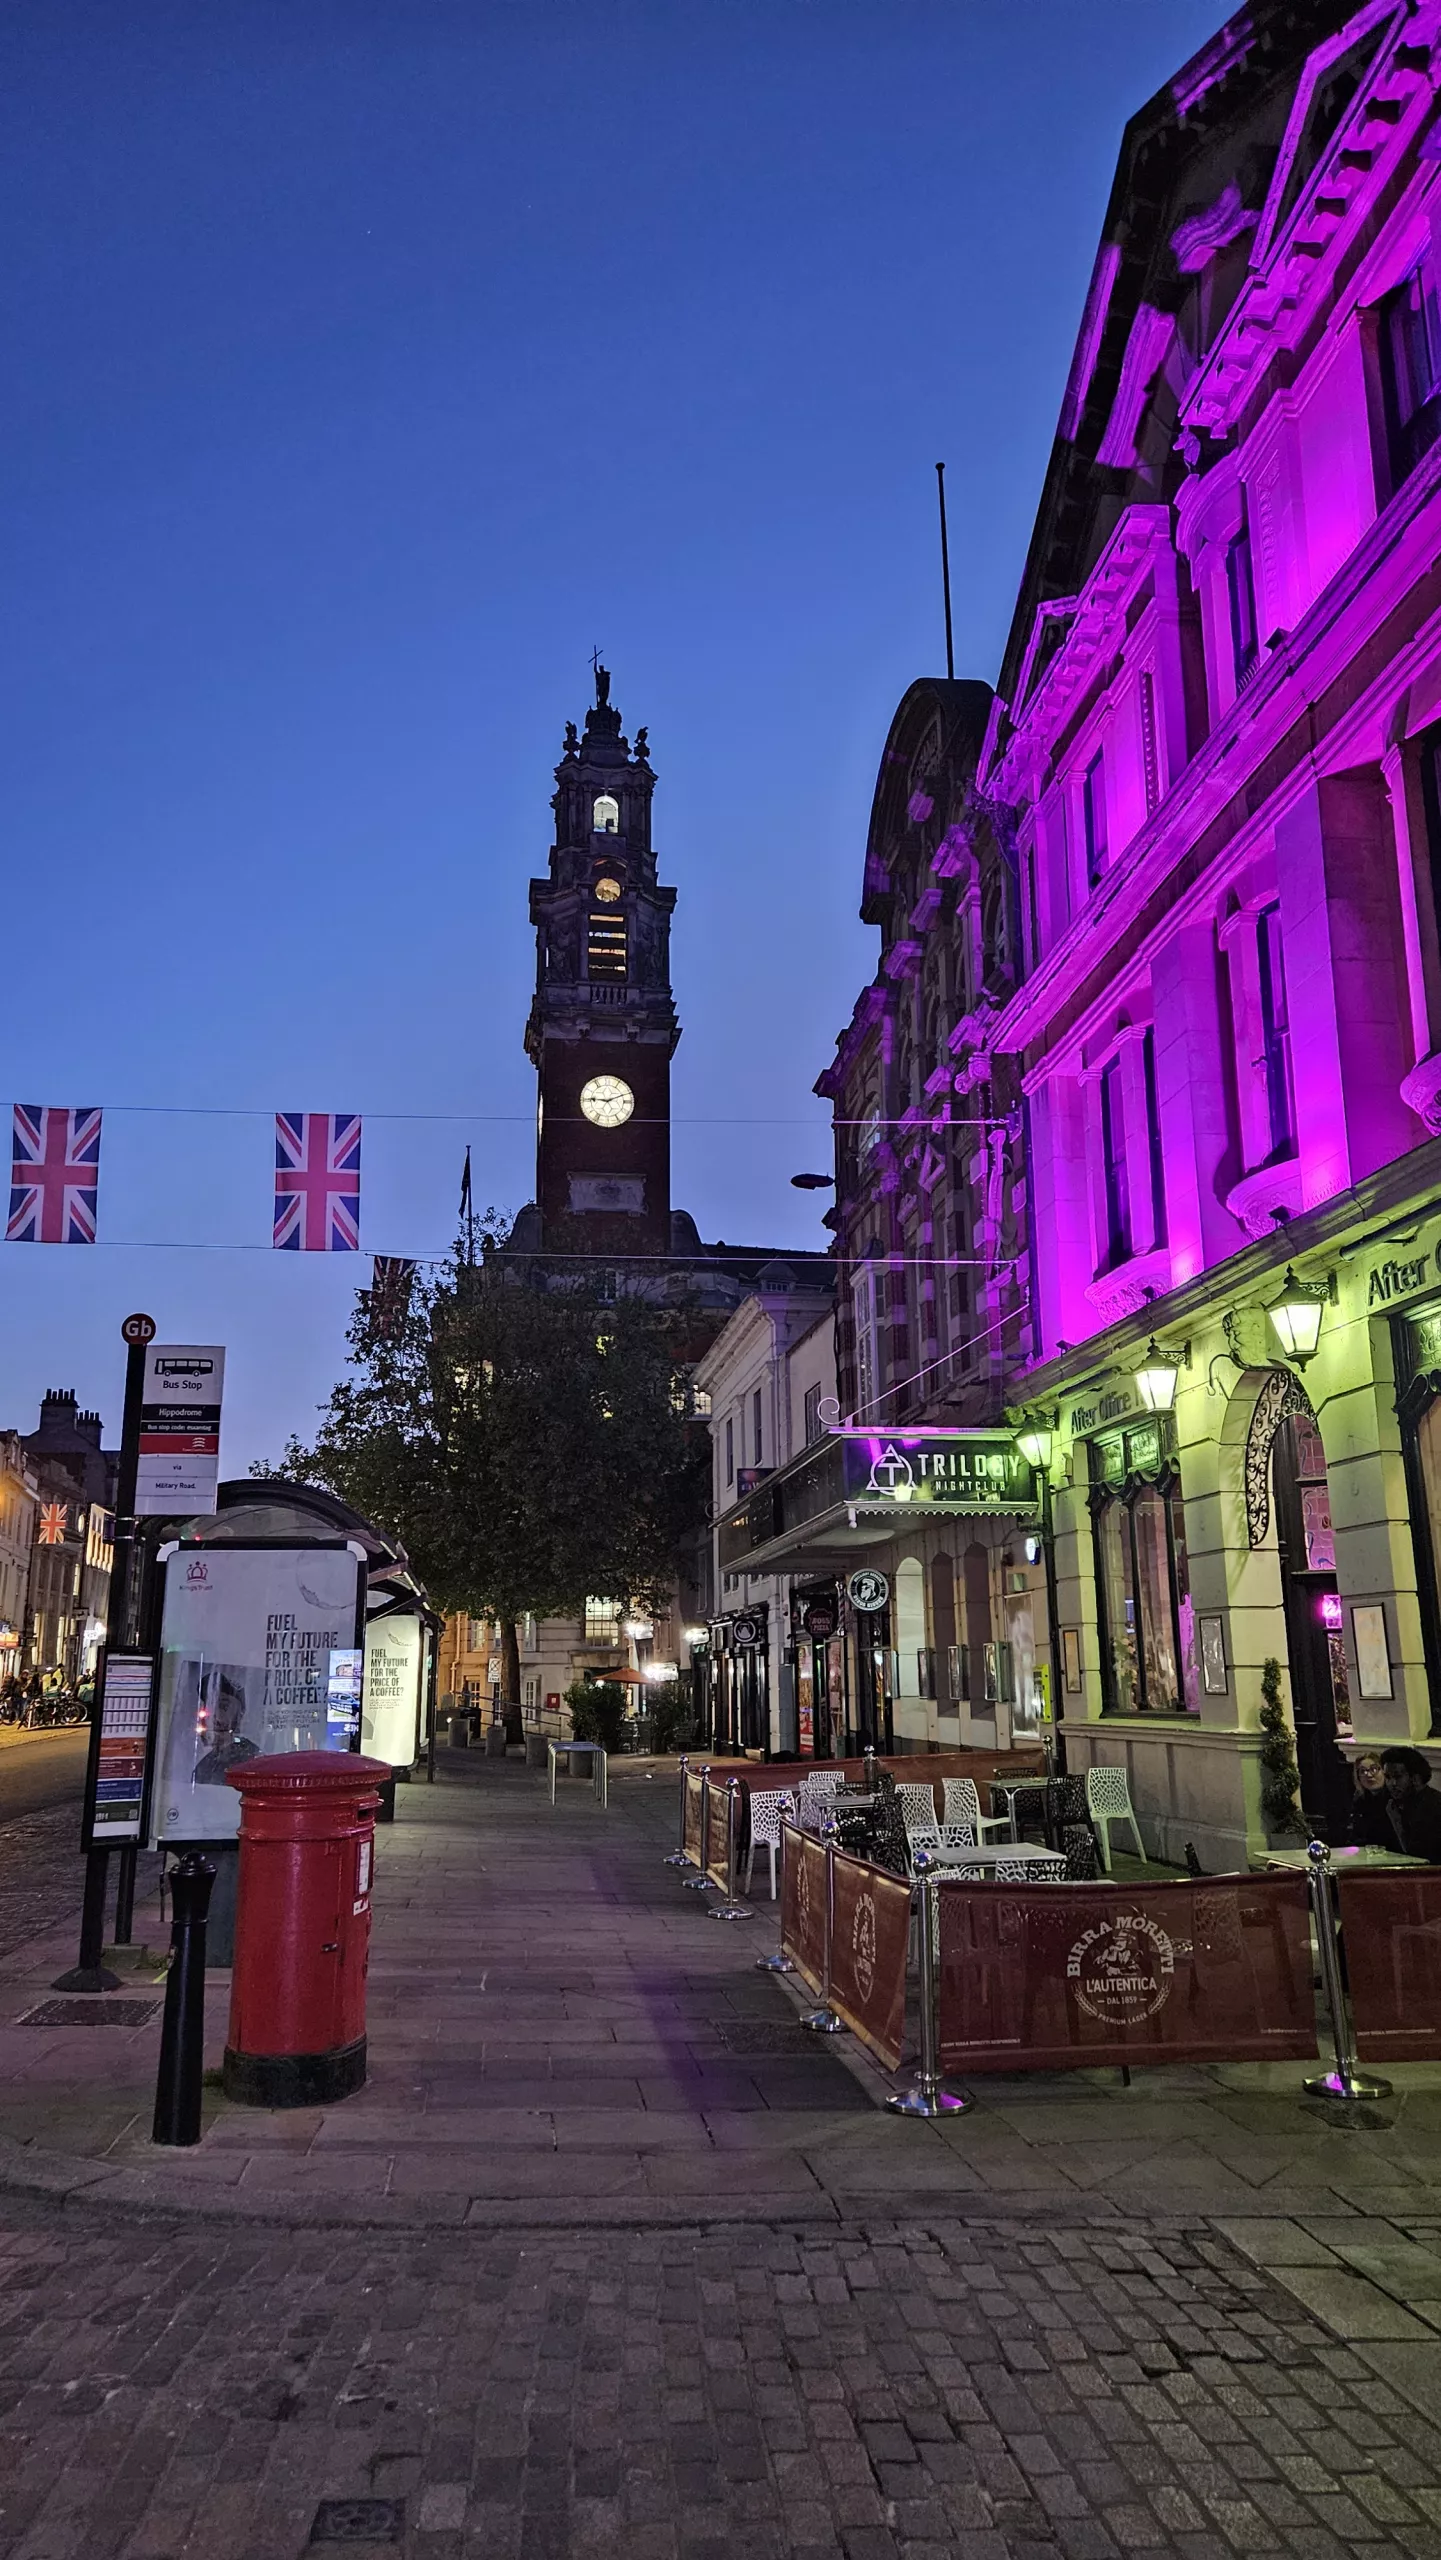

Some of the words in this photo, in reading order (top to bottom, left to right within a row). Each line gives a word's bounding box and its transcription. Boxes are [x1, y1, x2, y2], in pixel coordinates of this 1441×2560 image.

[1368, 1253, 1430, 1306] After
[125, 1320, 152, 1338] Gb
[163, 1380, 180, 1389] Bus
[182, 1380, 202, 1391] Stop
[159, 1408, 203, 1417] Hippodrome
[1071, 1407, 1097, 1434] After
[1099, 1391, 1132, 1420] Office
[917, 1454, 1020, 1477] TRILOGY
[935, 1481, 1006, 1492] NIGHTCLUB
[267, 1614, 298, 1631] FUEL
[266, 1632, 288, 1649] MY
[290, 1631, 338, 1649] FUTURE
[266, 1651, 290, 1667] FOR
[293, 1650, 317, 1667] THE
[371, 1648, 387, 1657] FUEL
[370, 1658, 381, 1667] MY
[383, 1658, 408, 1667] FUTURE
[370, 1668, 383, 1677] FOR
[385, 1668, 398, 1676] THE
[370, 1678, 389, 1687] PRICE
[391, 1677, 400, 1686] OF
[369, 1688, 374, 1696] A
[376, 1687, 404, 1696] COFFEE?
[1067, 1921, 1113, 1977] BIRRA
[1114, 1916, 1175, 1974] MORETTI
[1086, 1977, 1157, 1993] L'AUTENTICA
[1107, 1997, 1120, 2005] DAL
[1098, 2013, 1126, 2025] PREMIUM
